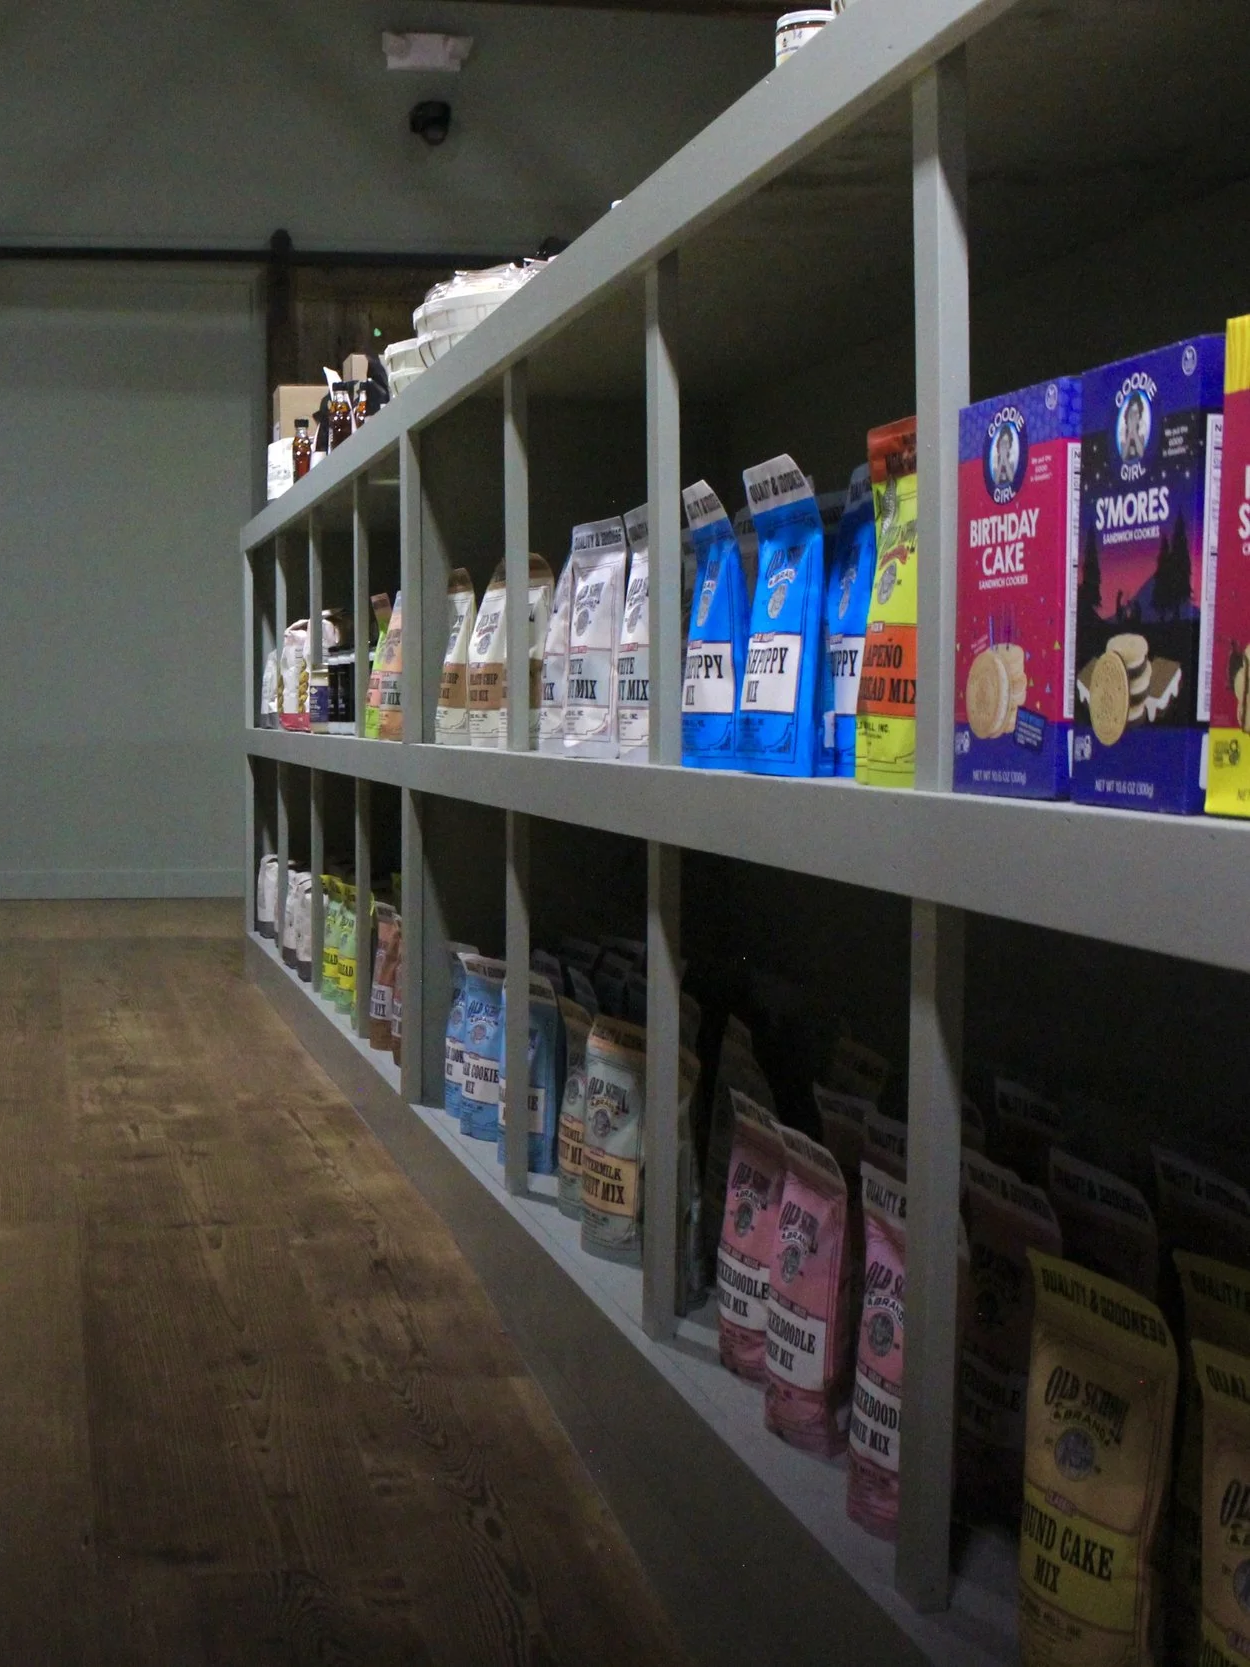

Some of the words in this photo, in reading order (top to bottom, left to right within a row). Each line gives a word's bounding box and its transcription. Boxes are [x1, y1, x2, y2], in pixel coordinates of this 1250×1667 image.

[1115, 372, 1158, 409] GOODIE
[988, 406, 1025, 439] GOODIE
[1121, 463, 1146, 483] GIRL
[993, 486, 1017, 504] GIRL
[1095, 485, 1170, 532] S'MORES
[969, 507, 1040, 549] BIRTHDAY
[1103, 530, 1134, 545] SANDWICH
[1134, 525, 1160, 542] COOKIES
[982, 541, 1025, 577] CAKE
[978, 577, 1005, 592] SANDWICH
[575, 679, 597, 700] MIX
[627, 679, 650, 701] MIX
[1095, 778, 1105, 792] NET
[471, 1065, 499, 1084] COOKIE
[601, 1181, 625, 1206] MIX
[865, 1260, 892, 1295] OLD
[1041, 1267, 1087, 1308] QUALITY
[1089, 1288, 1099, 1314] &
[732, 1296, 748, 1318] MIX
[779, 1347, 795, 1372] MIX
[1045, 1366, 1081, 1406] OLD
[869, 1428, 890, 1457] MIX
[1060, 1526, 1115, 1582] CAKE
[1033, 1554, 1061, 1595] MIX
